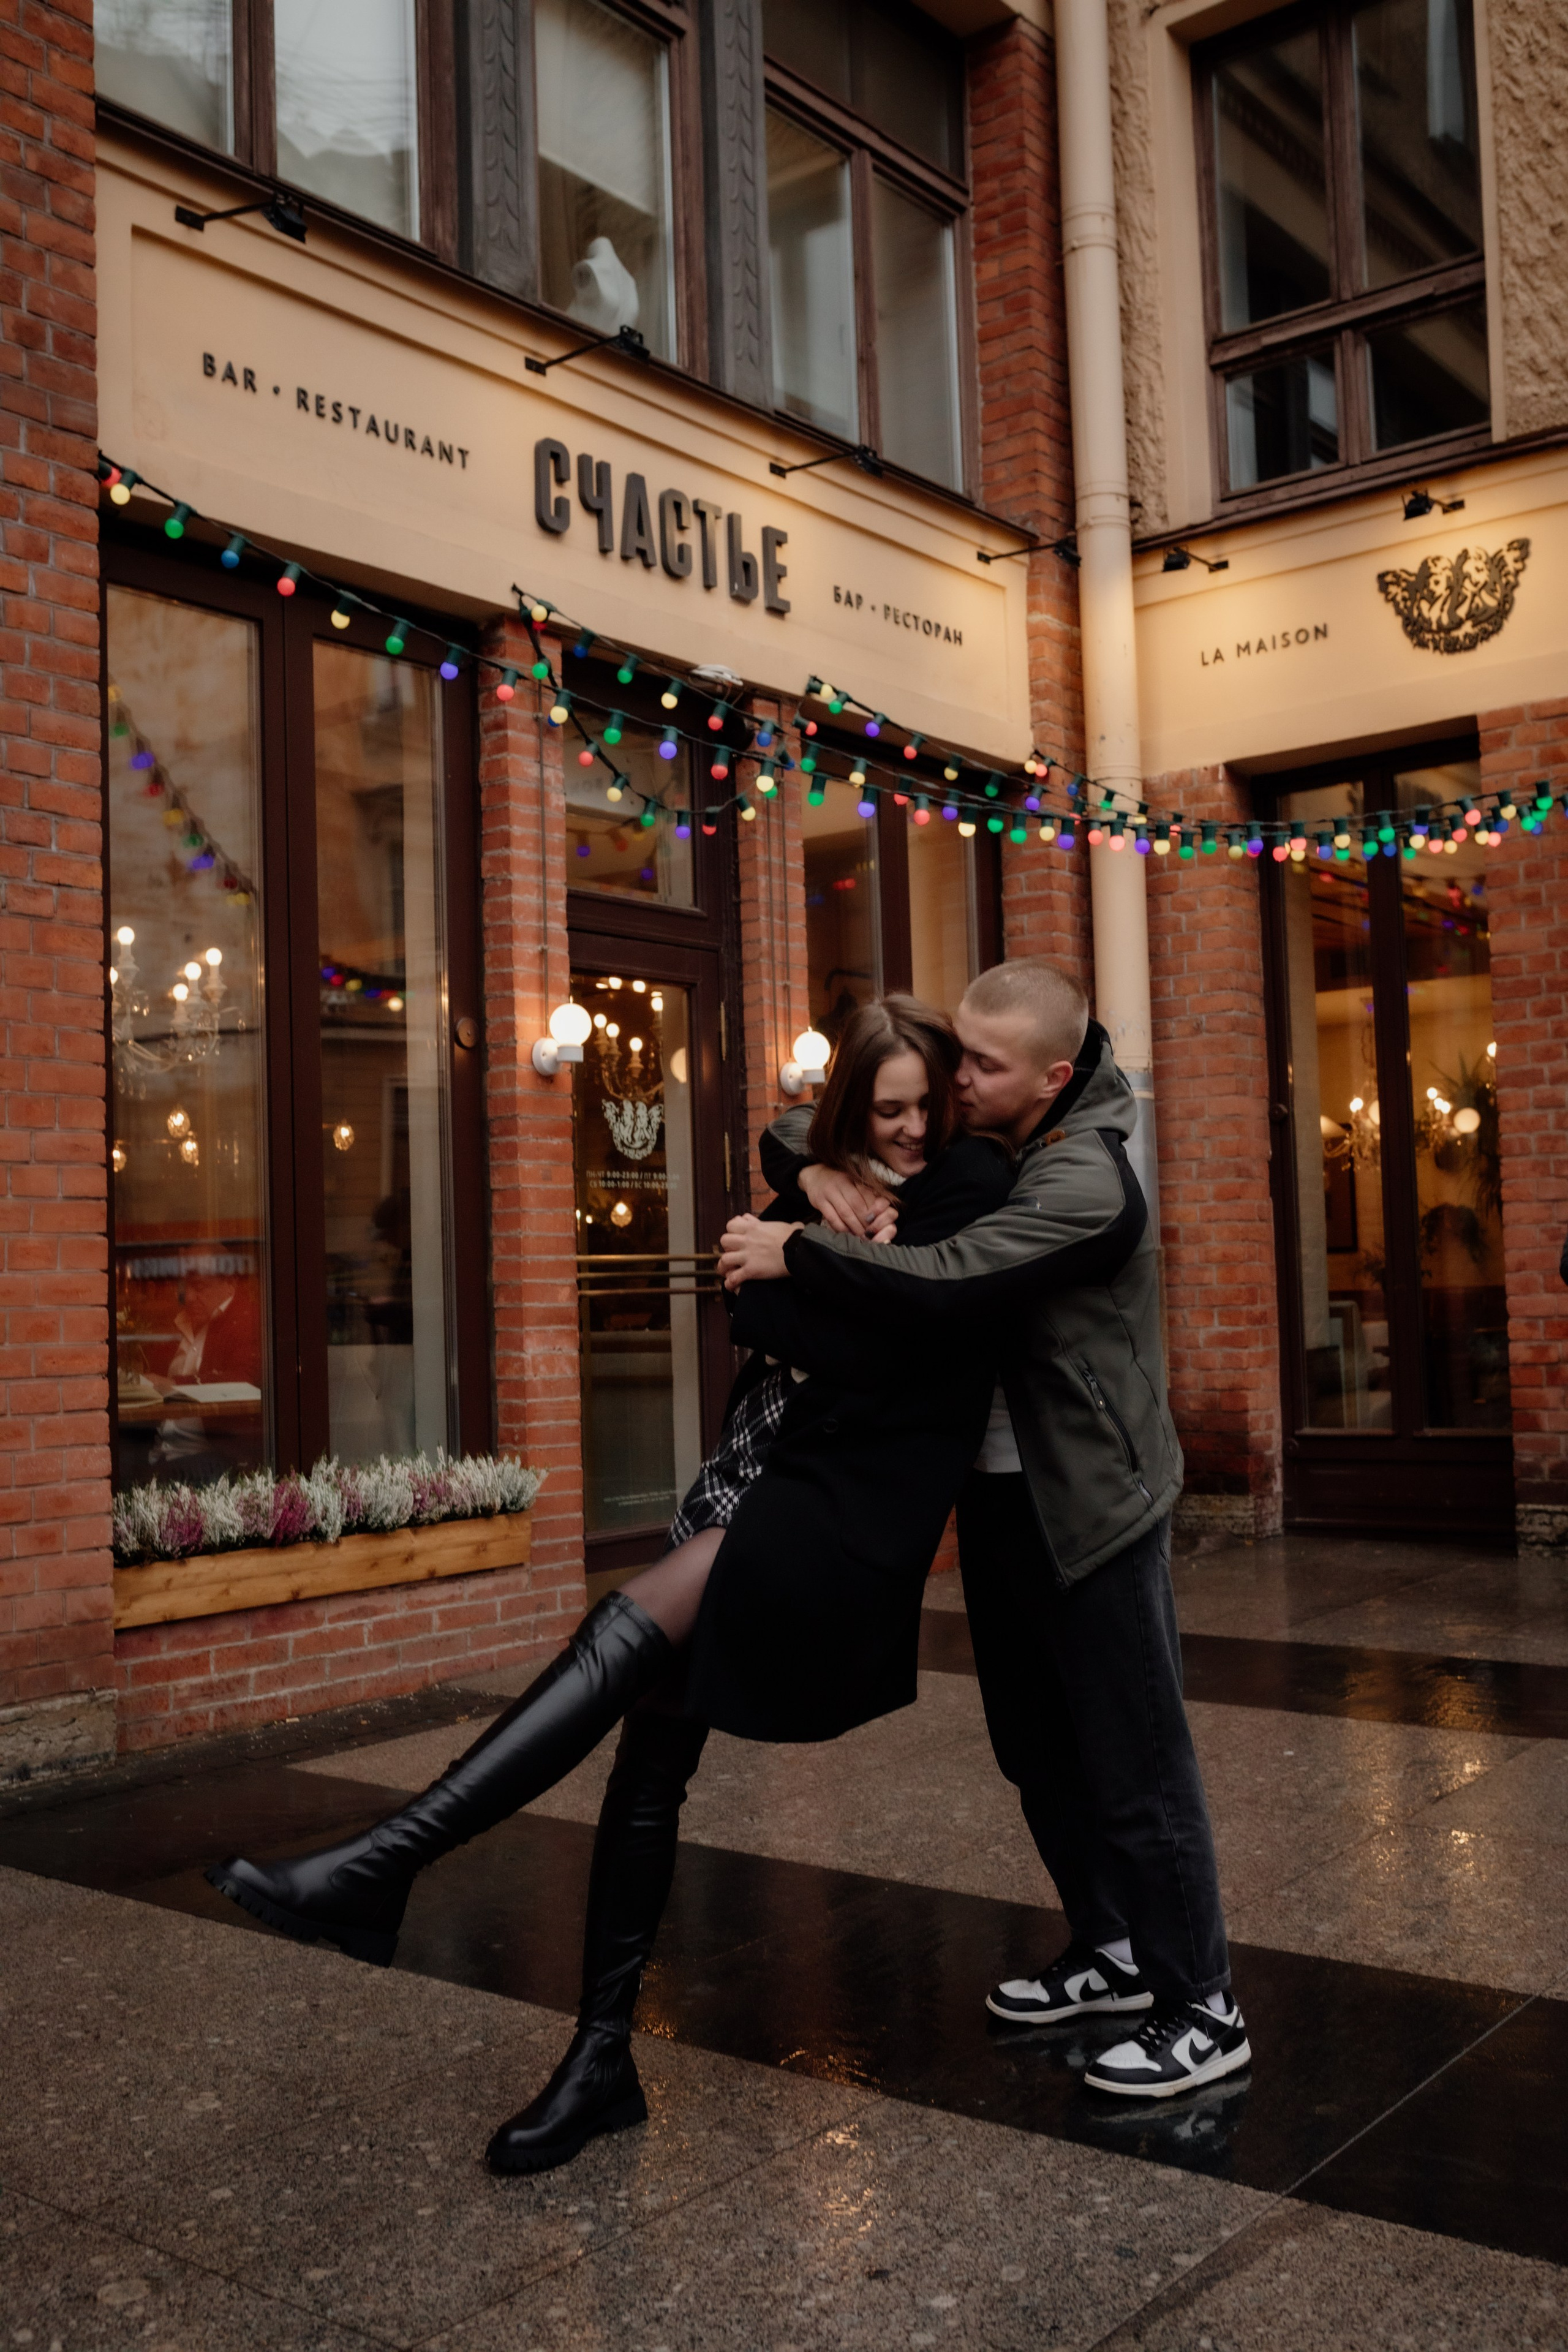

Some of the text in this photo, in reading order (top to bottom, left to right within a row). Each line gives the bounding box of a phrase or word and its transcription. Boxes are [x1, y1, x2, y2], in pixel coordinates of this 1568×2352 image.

[203, 352, 469, 469] BAR RESTAURANT
[534, 437, 791, 616] СЧАСТЬЕ
[834, 585, 963, 646] БАР РЕСТОРАН
[1200, 622, 1329, 667] LA MAISON
